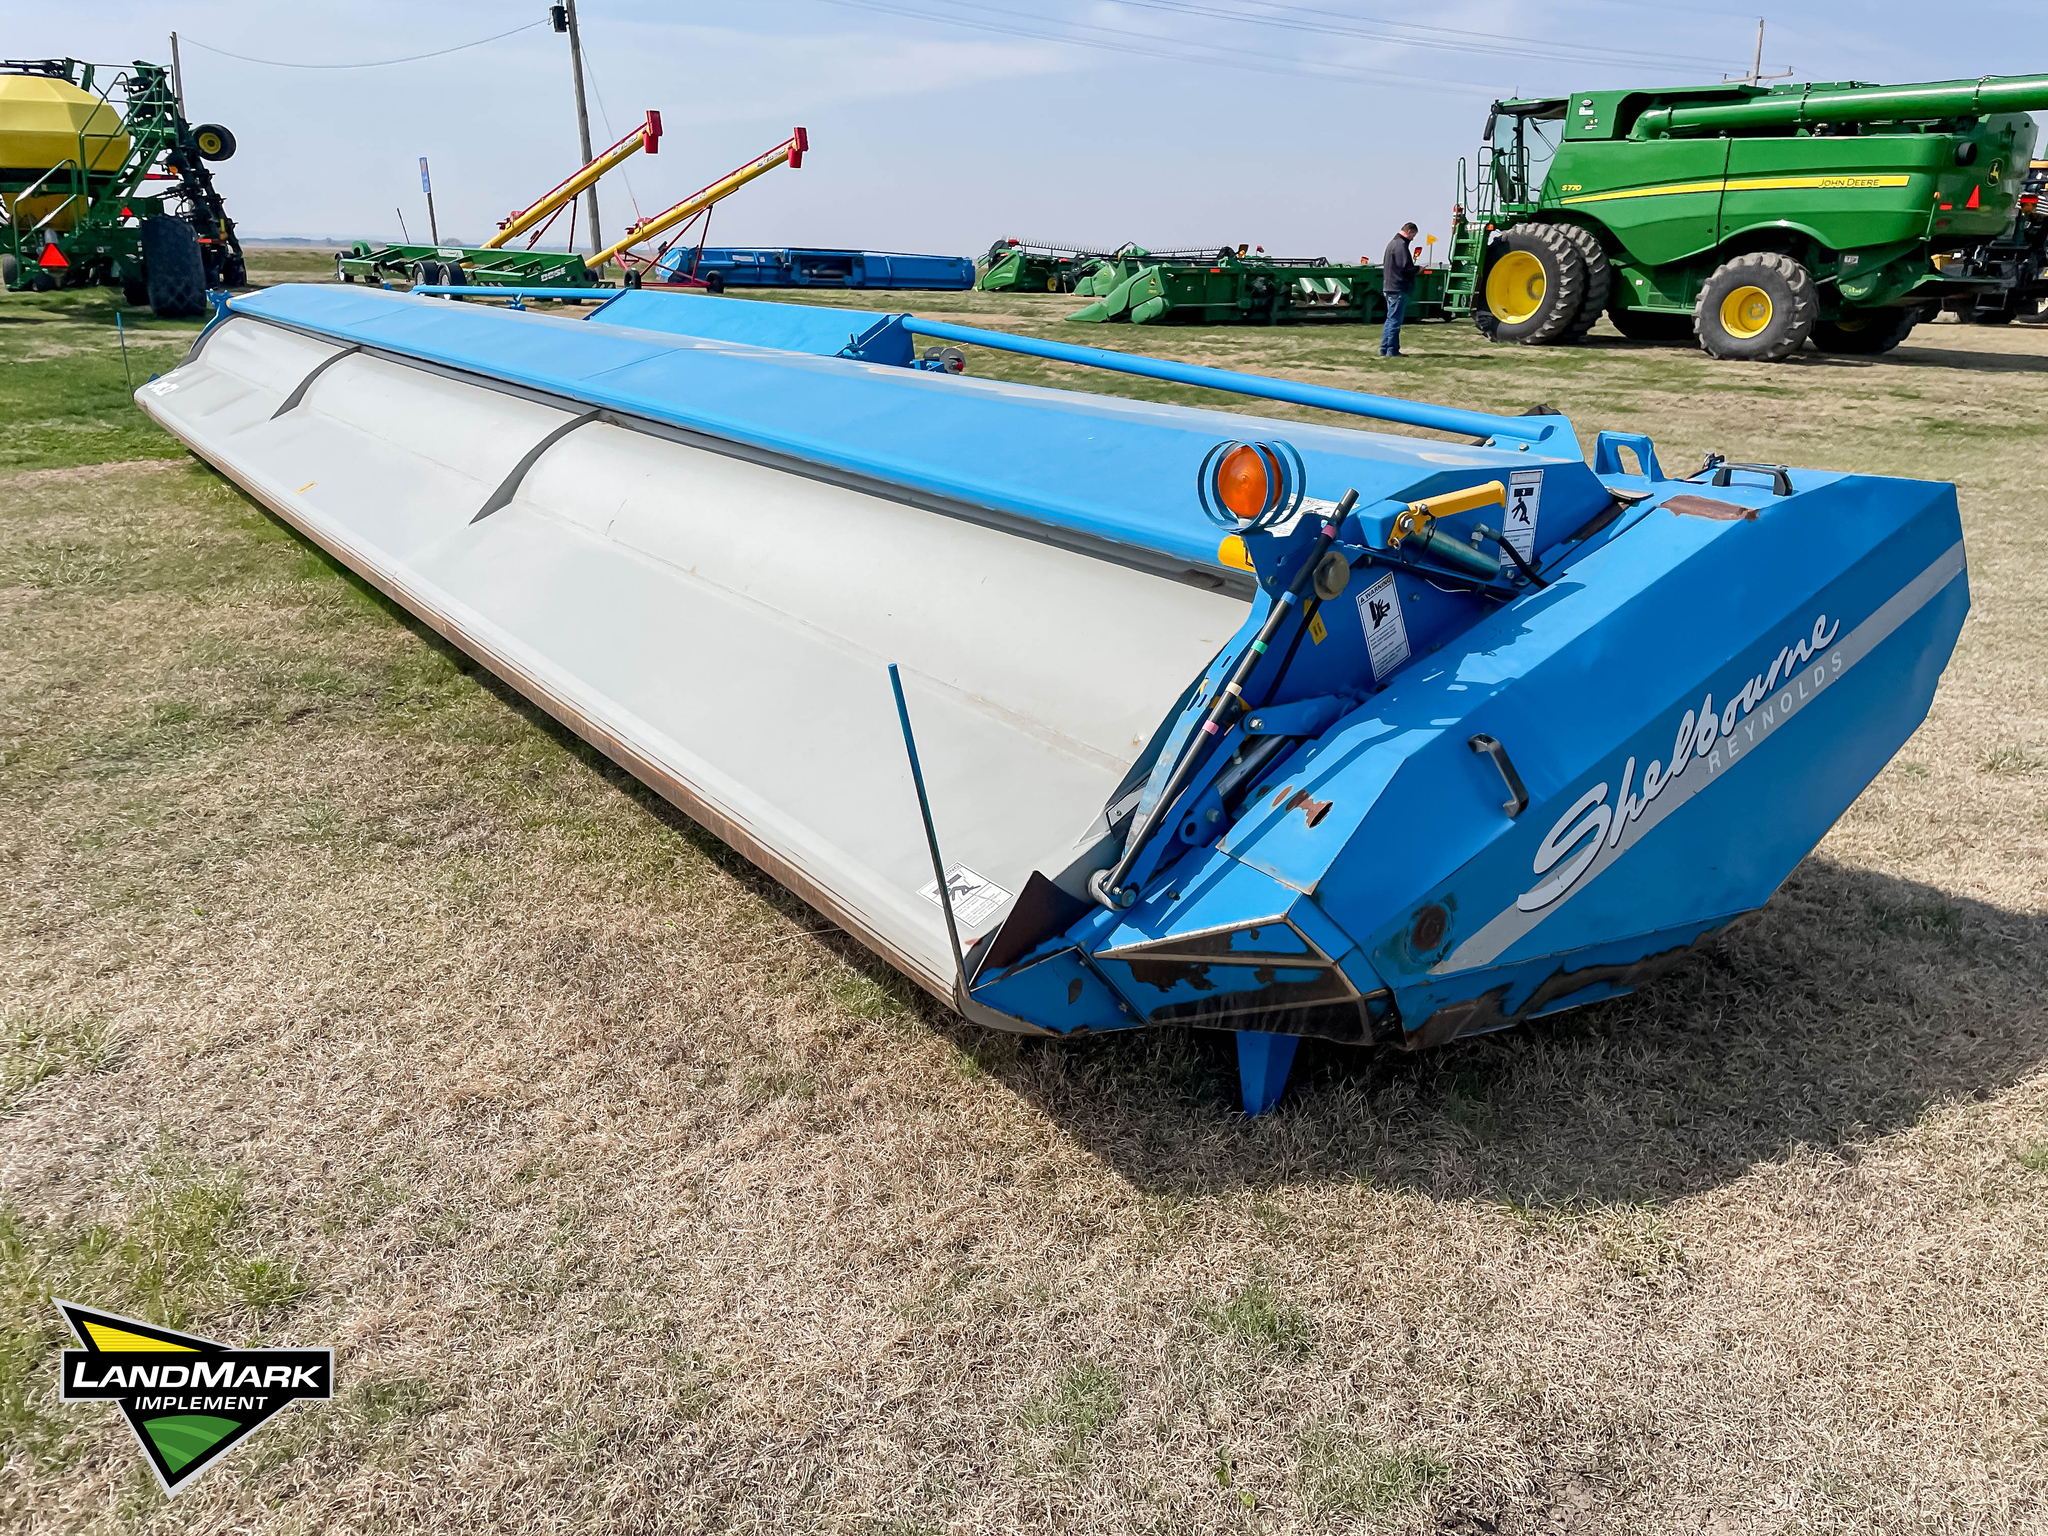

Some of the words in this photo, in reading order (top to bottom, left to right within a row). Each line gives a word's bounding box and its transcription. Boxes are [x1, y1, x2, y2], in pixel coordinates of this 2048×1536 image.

[1818, 179, 1845, 187] JOHN
[1846, 178, 1880, 187] DEERE
[1365, 576, 1392, 598] WARNING
[1707, 651, 1843, 774] REYNOLDS
[1517, 614, 1840, 912] Shelbourne
